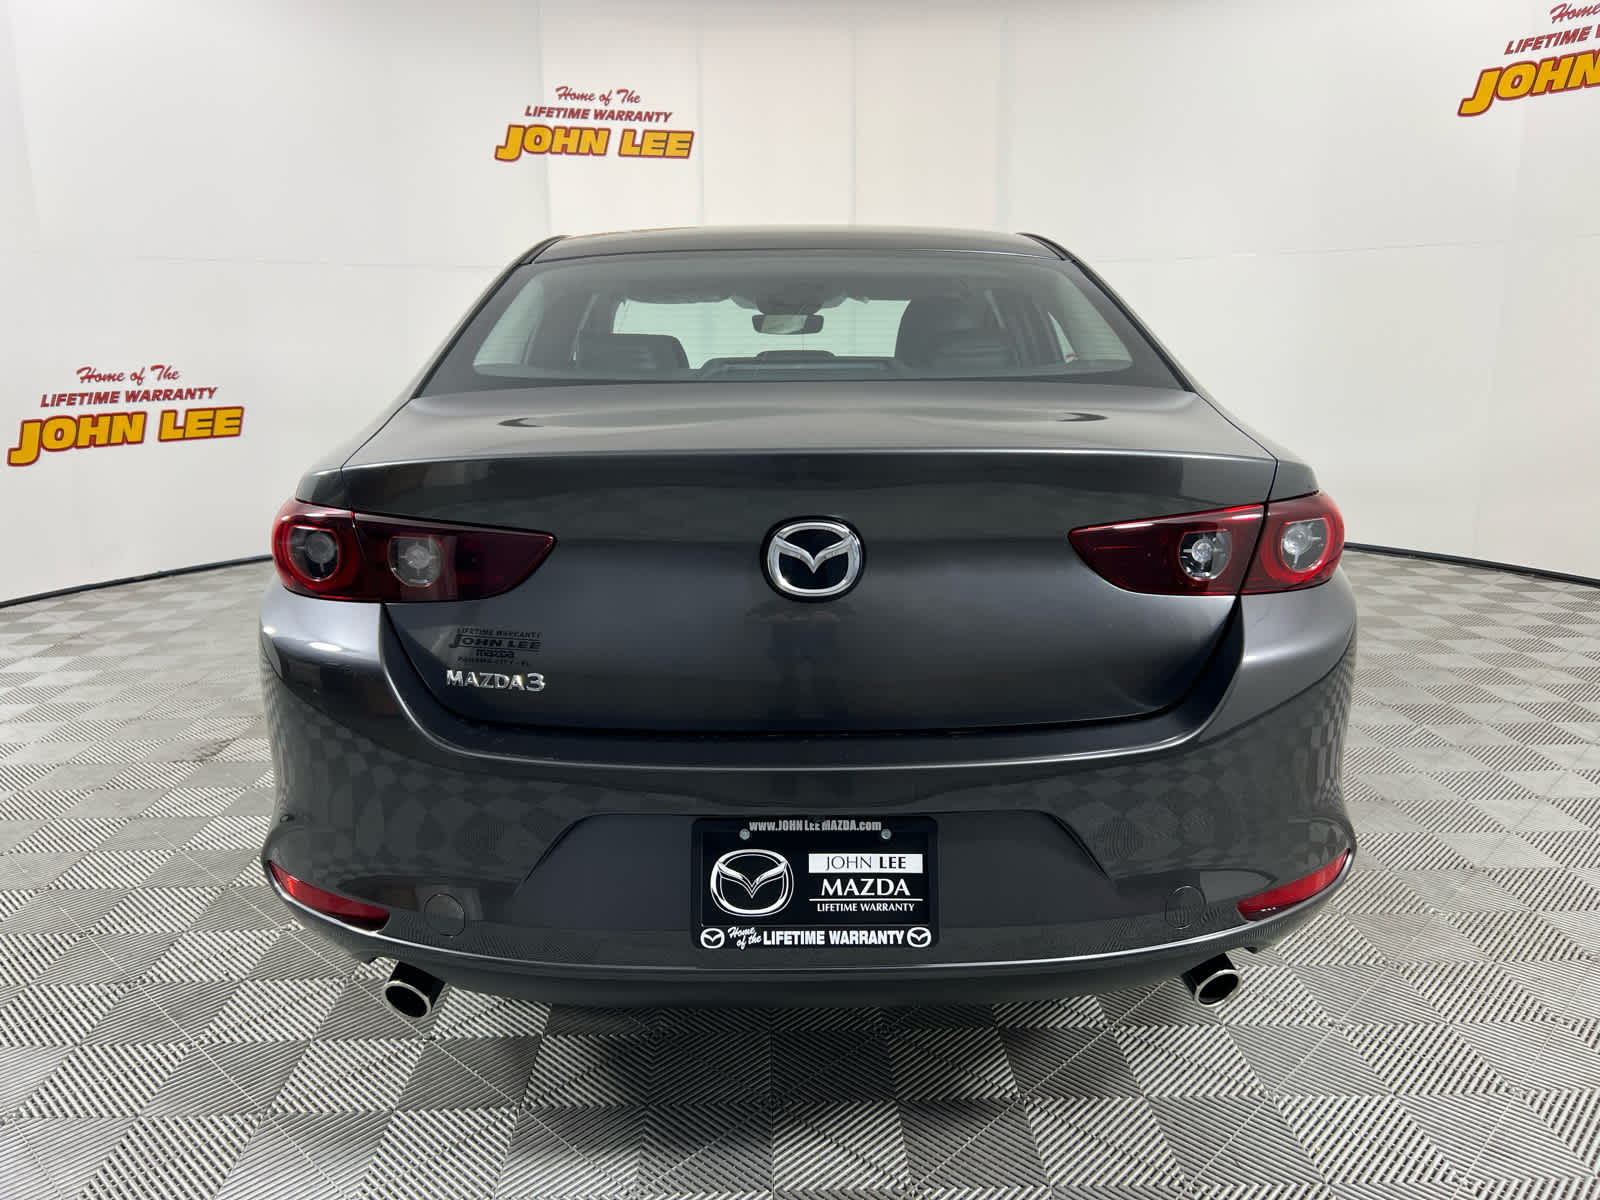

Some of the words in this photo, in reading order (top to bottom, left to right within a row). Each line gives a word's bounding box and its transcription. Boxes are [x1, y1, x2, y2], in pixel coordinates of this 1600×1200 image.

[1504, 25, 1592, 55] LIFETIME
[555, 86, 595, 102] Home
[599, 89, 612, 106] of
[616, 89, 640, 104] The
[524, 105, 590, 120] LIFETIME
[593, 108, 672, 123] WARRANTY
[494, 123, 611, 162] JOHN
[618, 128, 694, 159] LEE
[76, 366, 125, 384] Home
[130, 367, 146, 386] of
[150, 364, 180, 381] The
[40, 390, 120, 408] LIFETIME
[125, 387, 218, 403] WARRANTY
[7, 411, 148, 467] JOHN
[158, 406, 245, 443] LEE
[448, 633, 503, 649] JOHN
[506, 639, 541, 650] LEE
[446, 669, 546, 692] MAZDA3
[825, 855, 872, 871] JOHN
[879, 856, 907, 869] LEE
[821, 878, 911, 896] MAZDA
[817, 903, 858, 912] LIFETIME
[861, 903, 915, 912] WARRANTY
[727, 926, 756, 939] Home
[736, 938, 747, 951] of
[748, 932, 762, 946] the
[763, 930, 826, 946] LIFETIME
[828, 930, 904, 946] WARRANTY
